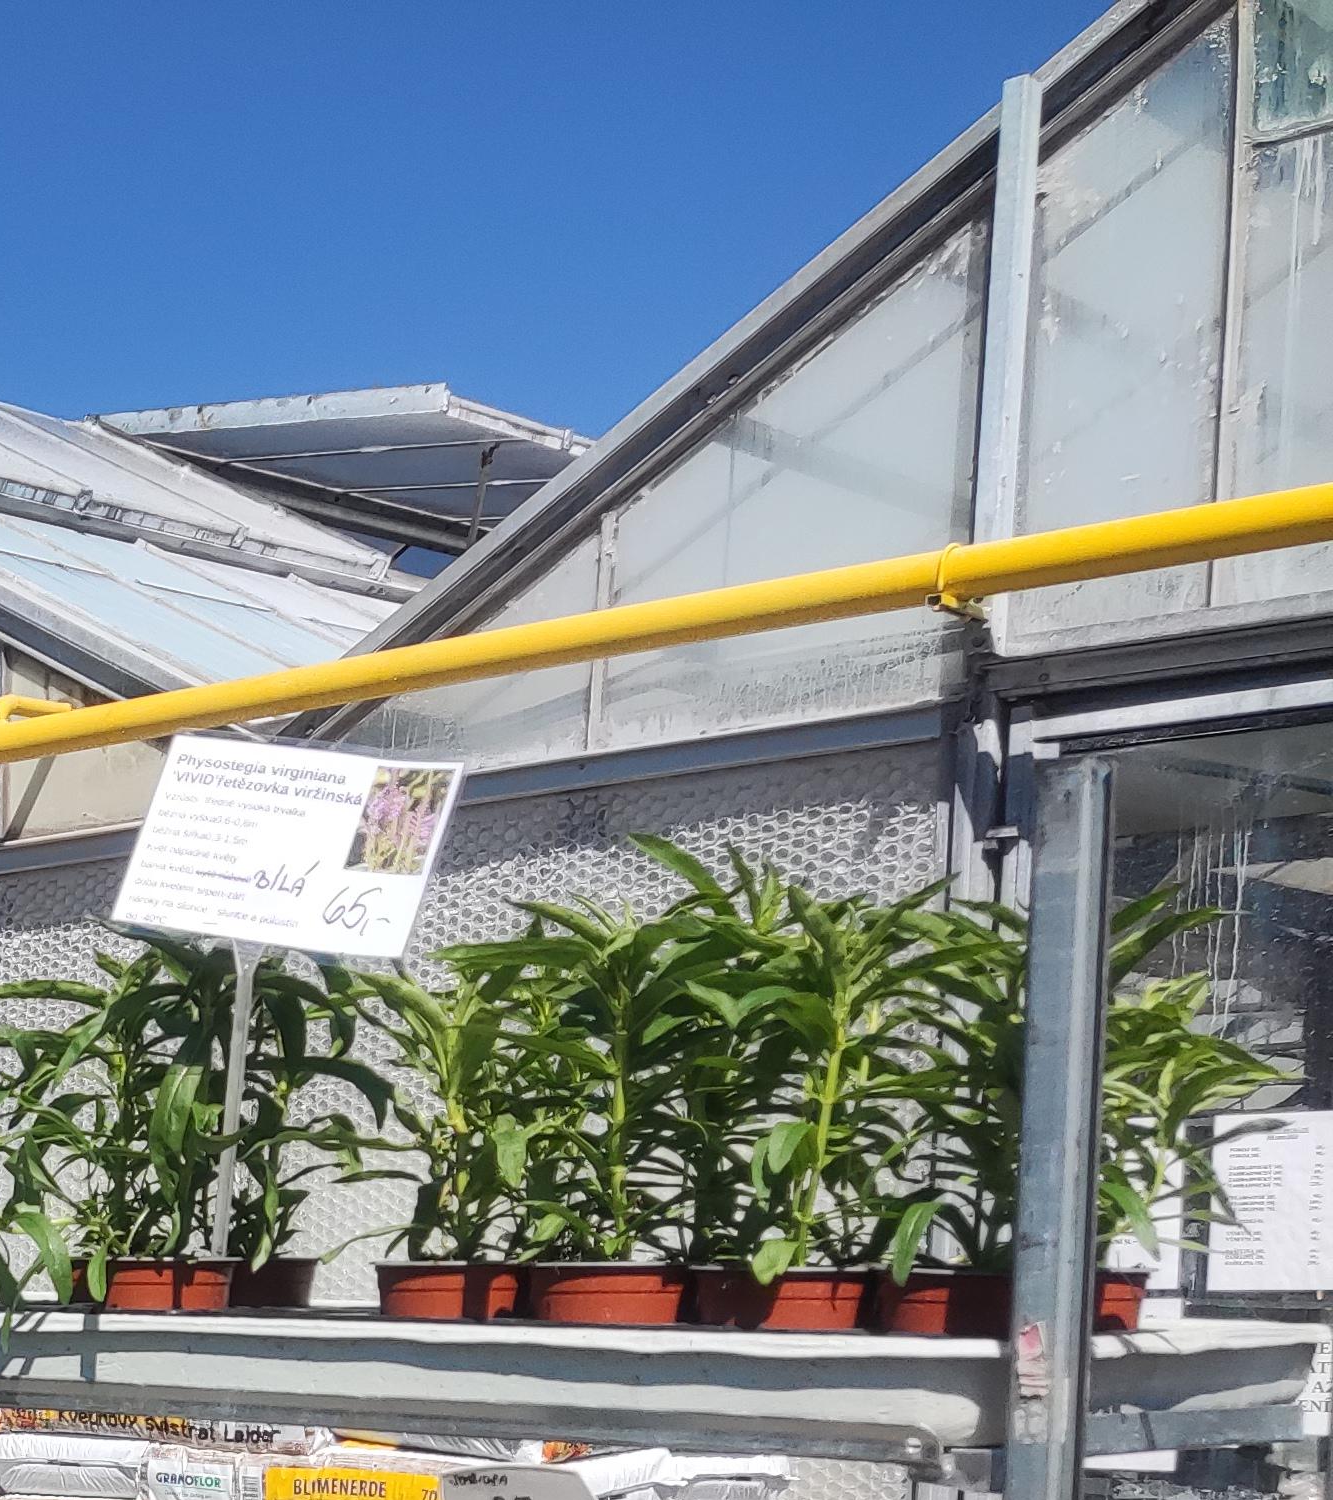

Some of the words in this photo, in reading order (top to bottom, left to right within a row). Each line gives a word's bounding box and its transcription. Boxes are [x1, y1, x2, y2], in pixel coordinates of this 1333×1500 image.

[177, 753, 266, 776] Physostegia
[271, 764, 347, 786] virginiana
[294, 786, 362, 806] viržinská
[155, 1471, 222, 1489] GRAMOFLOR
